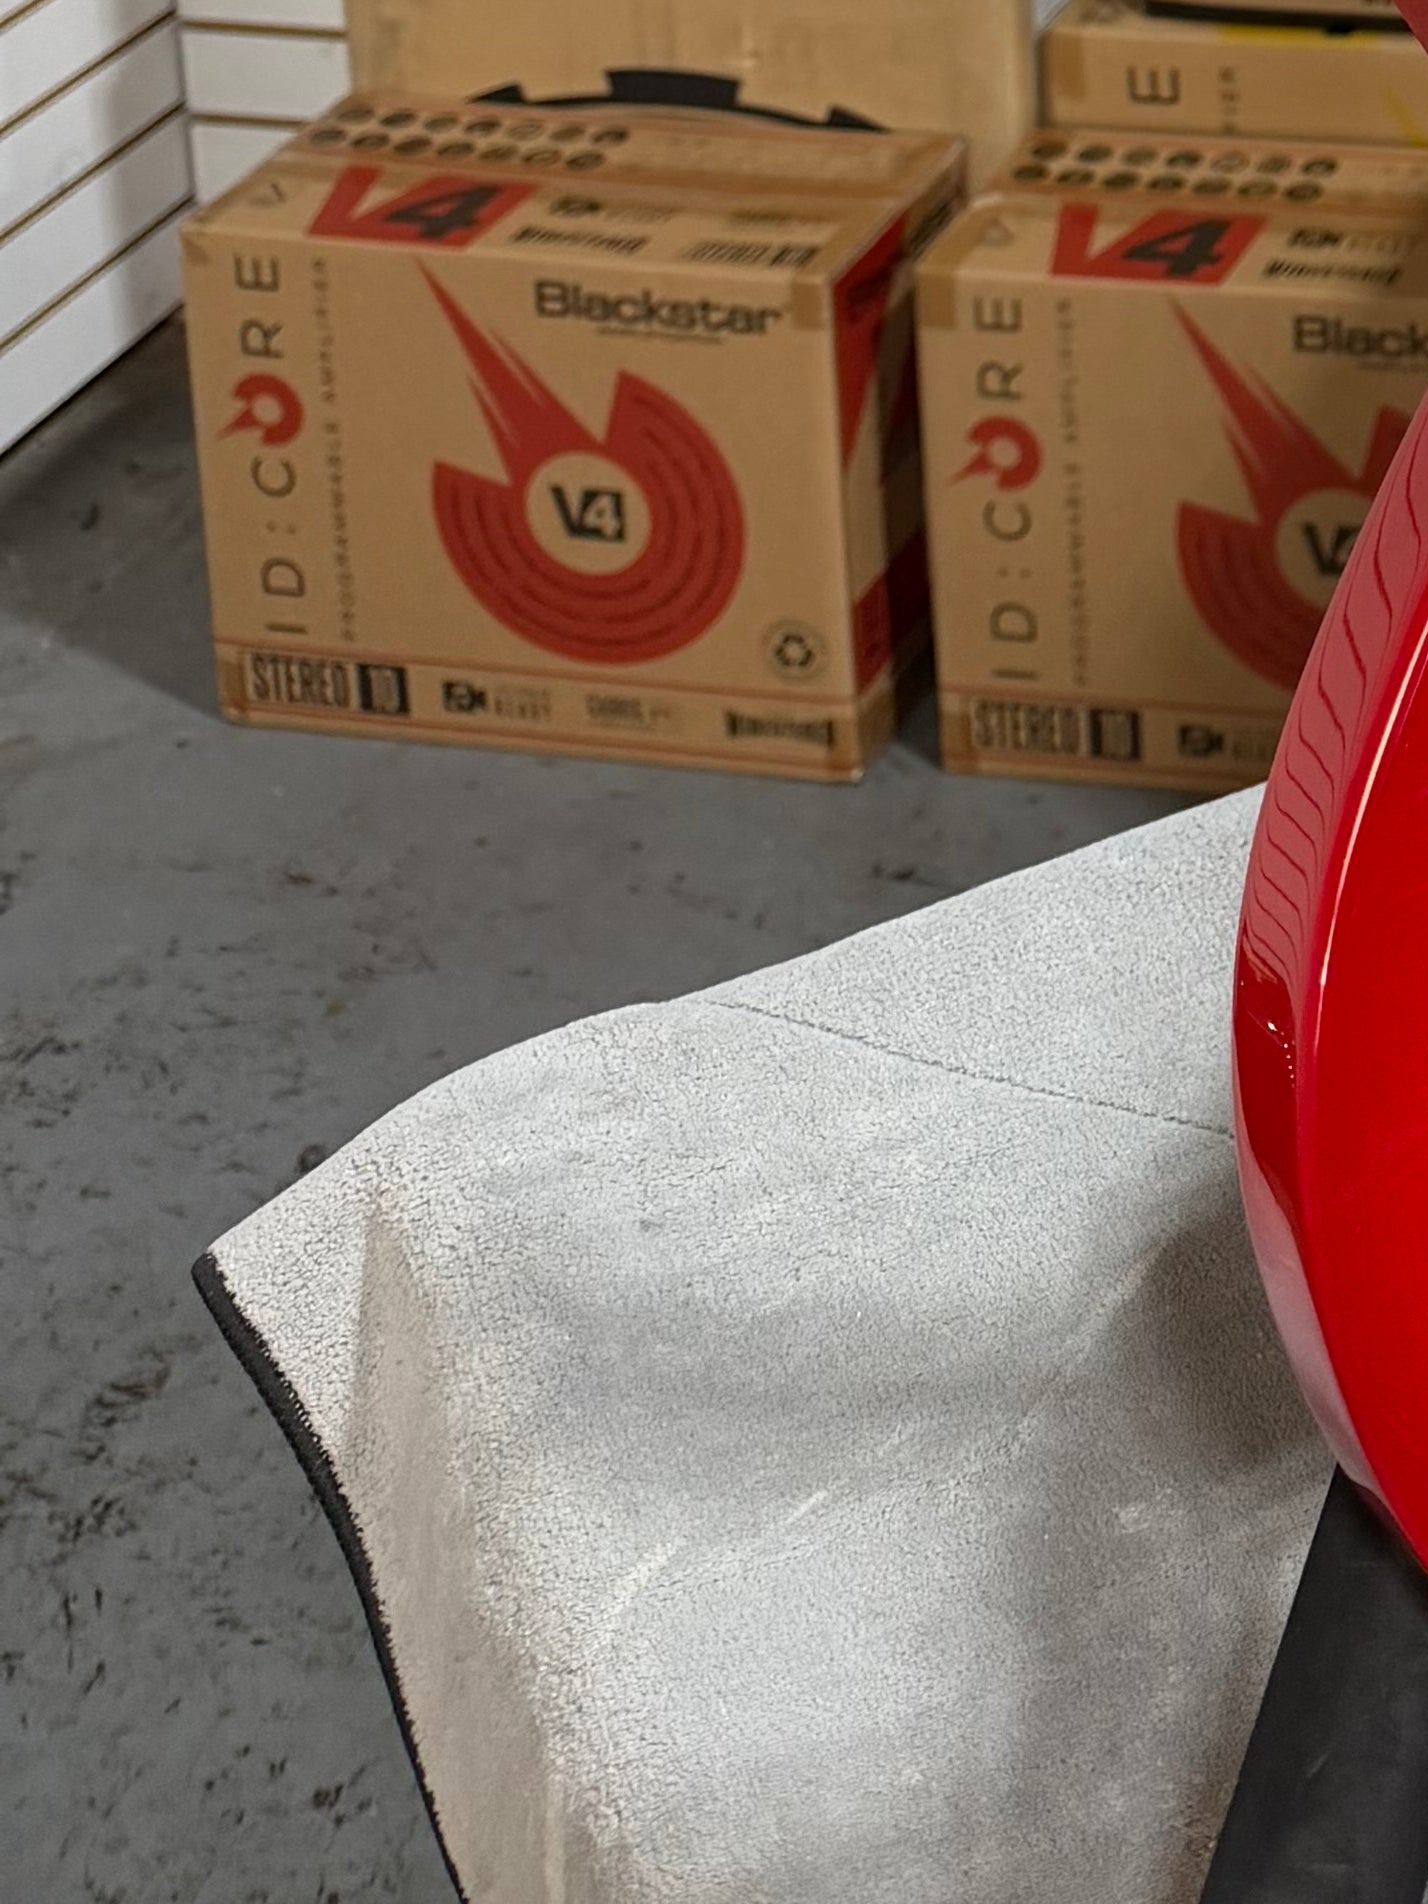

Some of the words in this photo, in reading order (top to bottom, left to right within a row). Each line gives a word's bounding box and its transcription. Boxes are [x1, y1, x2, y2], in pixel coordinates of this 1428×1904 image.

[306, 166, 541, 249] V4
[1050, 202, 1269, 285] V4
[534, 276, 782, 336] Blackstar
[550, 483, 627, 543] V4
[251, 652, 350, 708] STEREO
